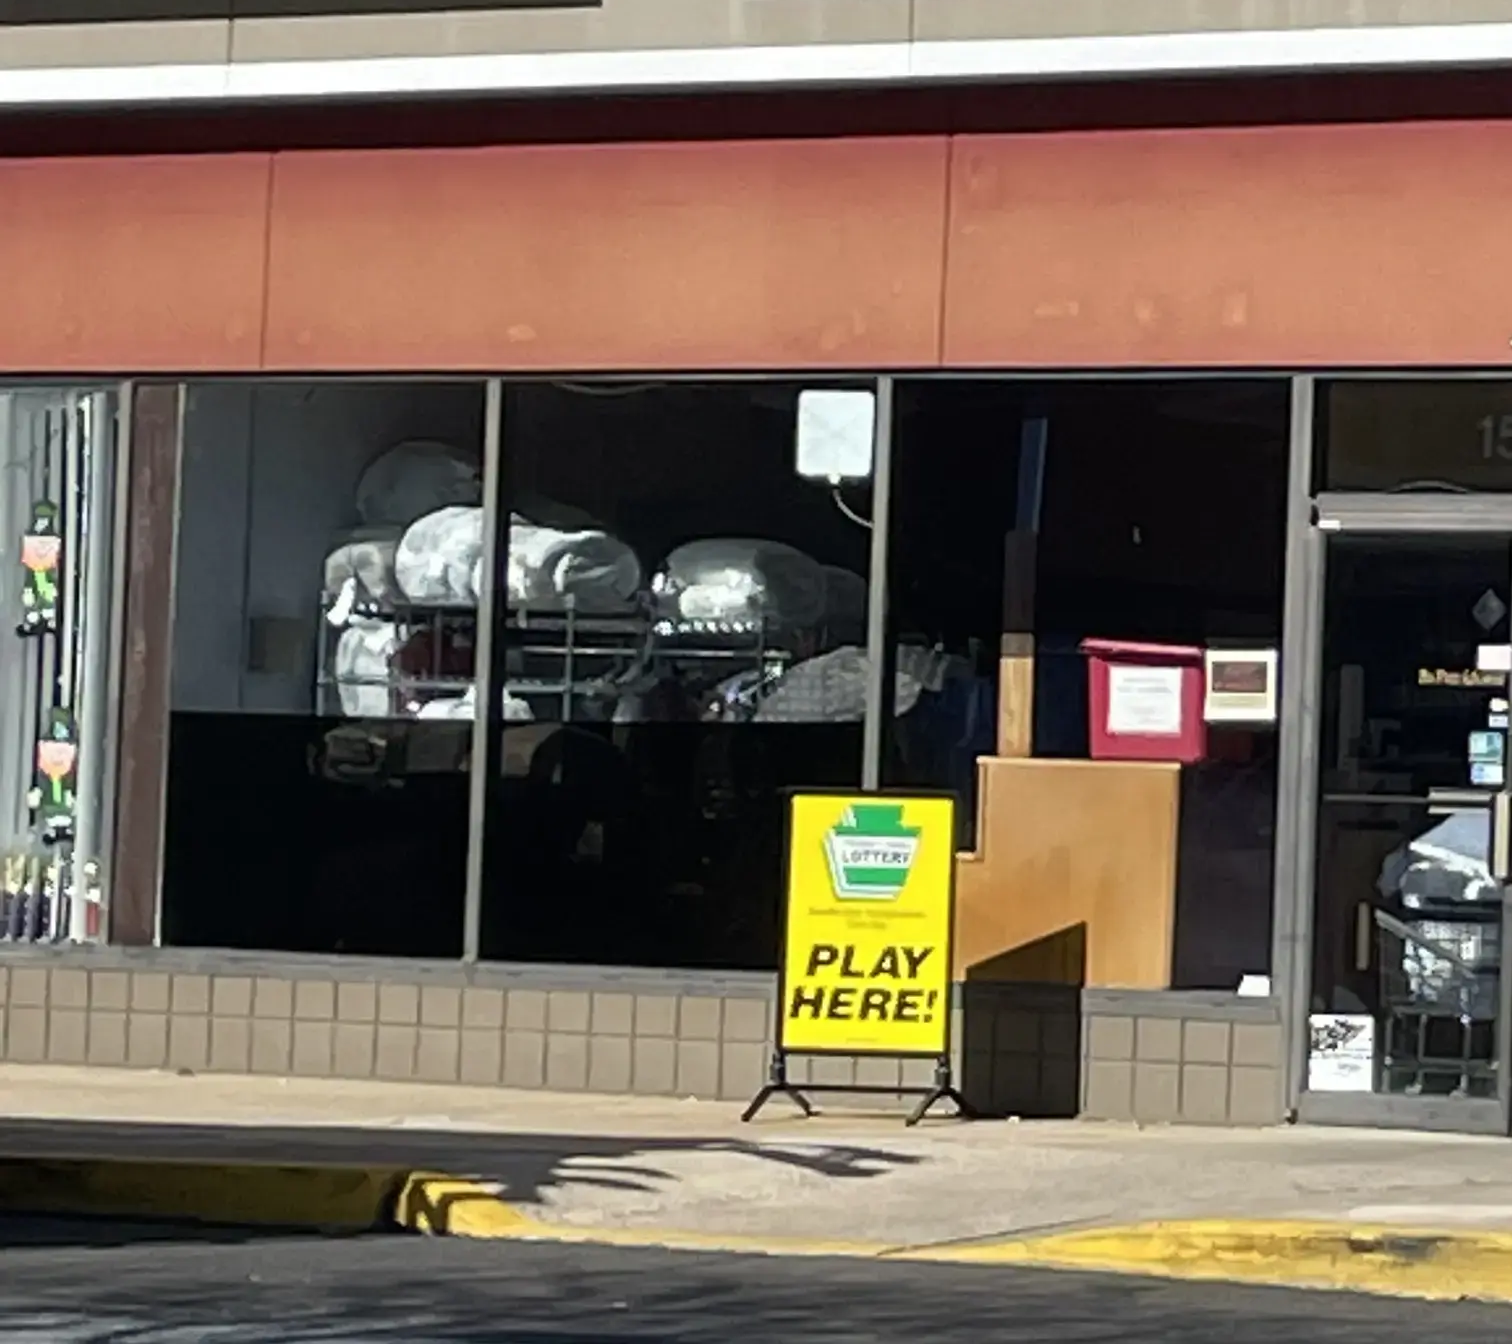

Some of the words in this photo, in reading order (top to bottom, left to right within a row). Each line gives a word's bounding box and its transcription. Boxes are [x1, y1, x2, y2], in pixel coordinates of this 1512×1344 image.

[841, 847, 912, 864] LOTTERY
[806, 942, 936, 979] PLAY
[789, 984, 938, 1024] HERE!
